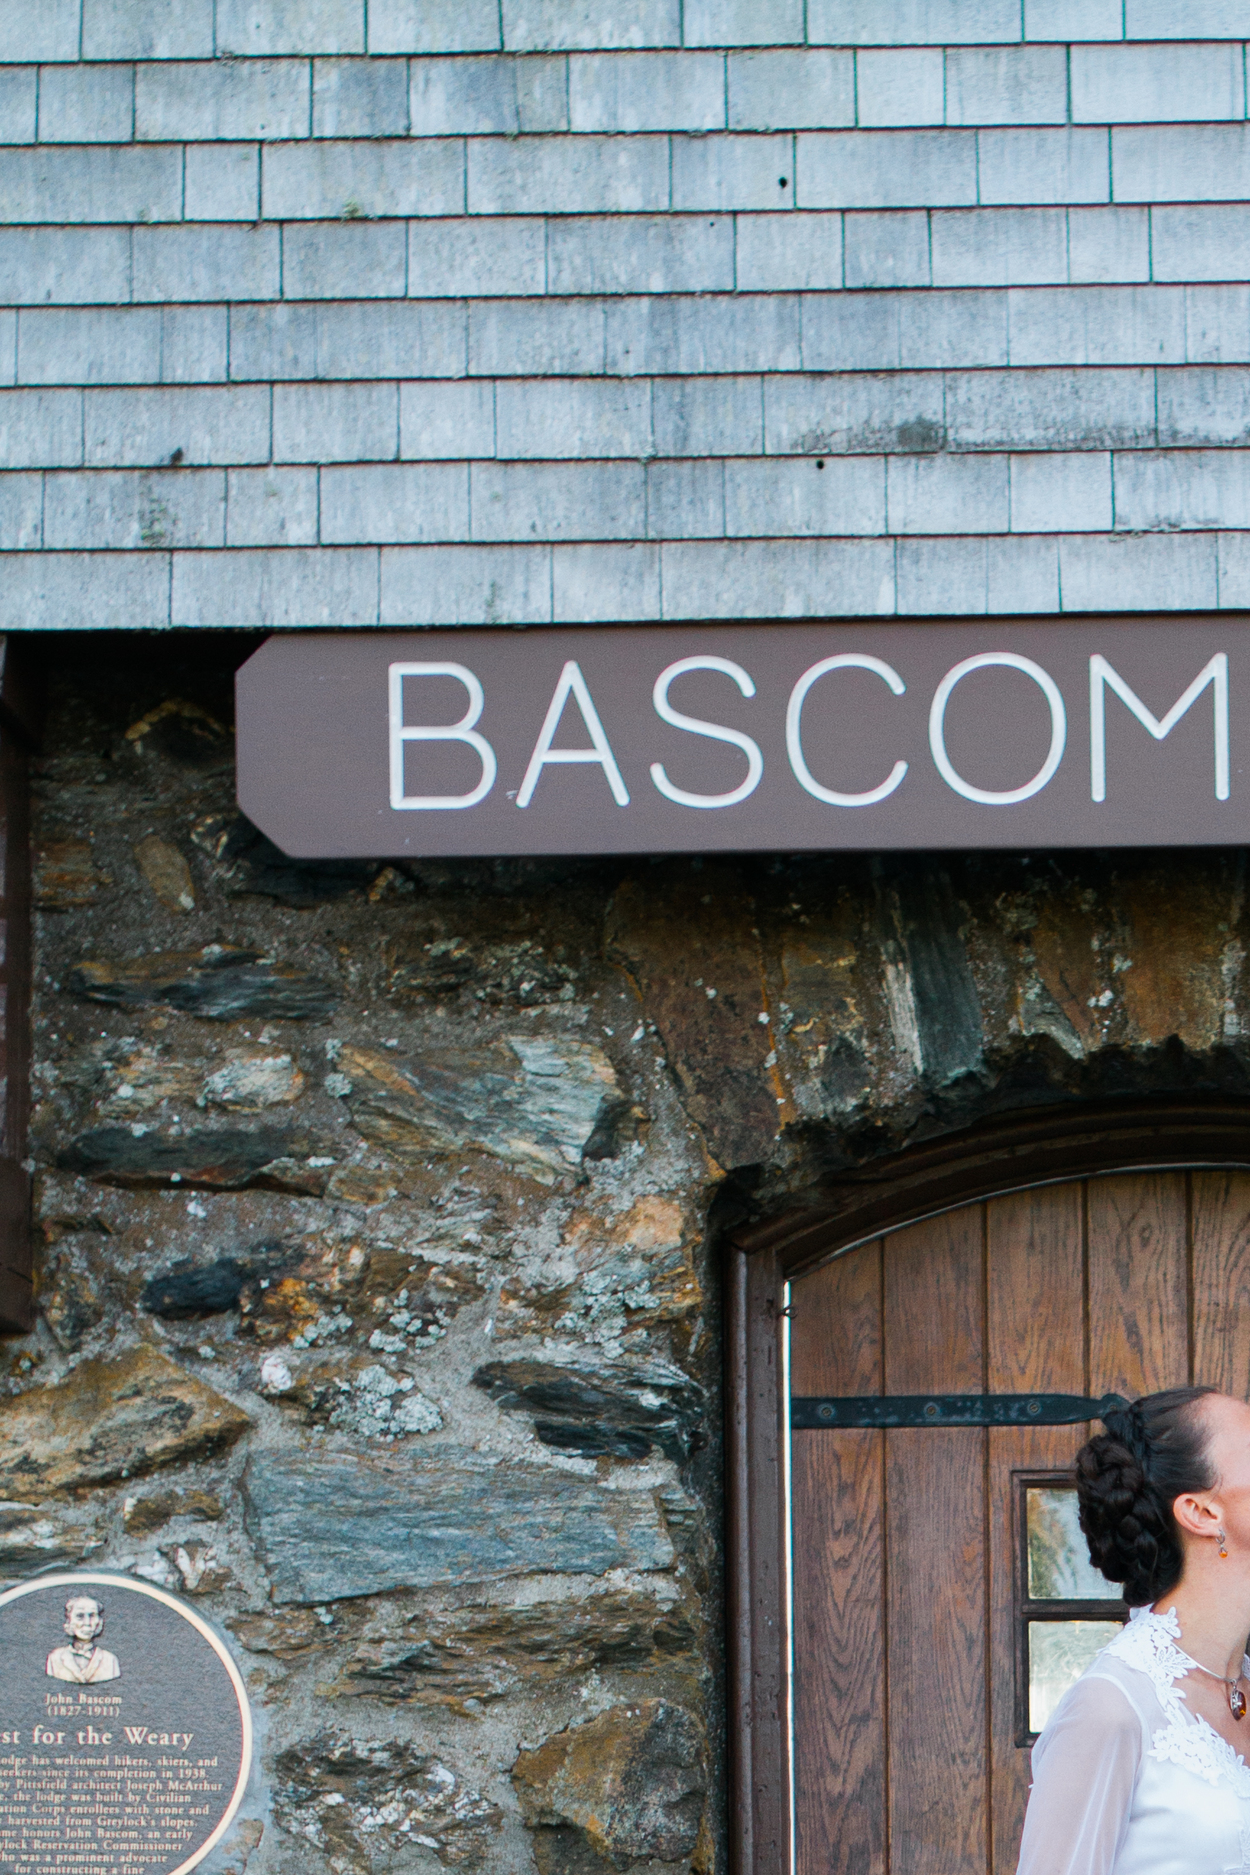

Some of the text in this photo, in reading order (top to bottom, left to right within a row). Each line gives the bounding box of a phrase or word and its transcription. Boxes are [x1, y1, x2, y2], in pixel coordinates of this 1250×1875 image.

[387, 651, 1229, 809] BASCOM
[46, 1693, 122, 1705] John Bascom
[47, 1705, 120, 1717] (1827-1911)
[0, 1724, 194, 1750] st for the Weary
[0, 1754, 28, 1768] odge
[32, 1754, 50, 1765] has
[54, 1754, 109, 1766] welcomed
[198, 1756, 218, 1766] and
[42, 1766, 70, 1777] since
[75, 1767, 89, 1777] its
[94, 1768, 156, 1780] completion
[162, 1768, 173, 1778] in
[16, 1779, 67, 1790] Pittsfield
[72, 1779, 121, 1790] architect
[126, 1780, 162, 1794] Joseph
[168, 1780, 222, 1791] McArthur
[14, 1790, 32, 1801] the
[36, 1791, 67, 1803] lodge
[96, 1792, 122, 1802] built
[128, 1792, 141, 1804] by
[146, 1792, 191, 1802] Civilian
[32, 1803, 65, 1816] Corps
[70, 1803, 120, 1814] enrollees
[125, 1804, 149, 1814] with
[155, 1806, 184, 1814] stone
[189, 1805, 209, 1815] and
[8, 1814, 60, 1825] harvested
[65, 1815, 91, 1825] from
[22, 1827, 60, 1837] honors
[65, 1828, 91, 1840] John
[97, 1828, 142, 1839] Bascom,
[148, 1831, 160, 1839] an
[166, 1829, 192, 1841] early
[0, 1839, 182, 1852] ylock Reservation Commissioner
[0, 1850, 15, 1861] ho
[55, 1852, 114, 1865] prominent
[119, 1852, 168, 1862] advocate
[14, 1863, 31, 1873] for
[123, 1865, 145, 1874] fine
